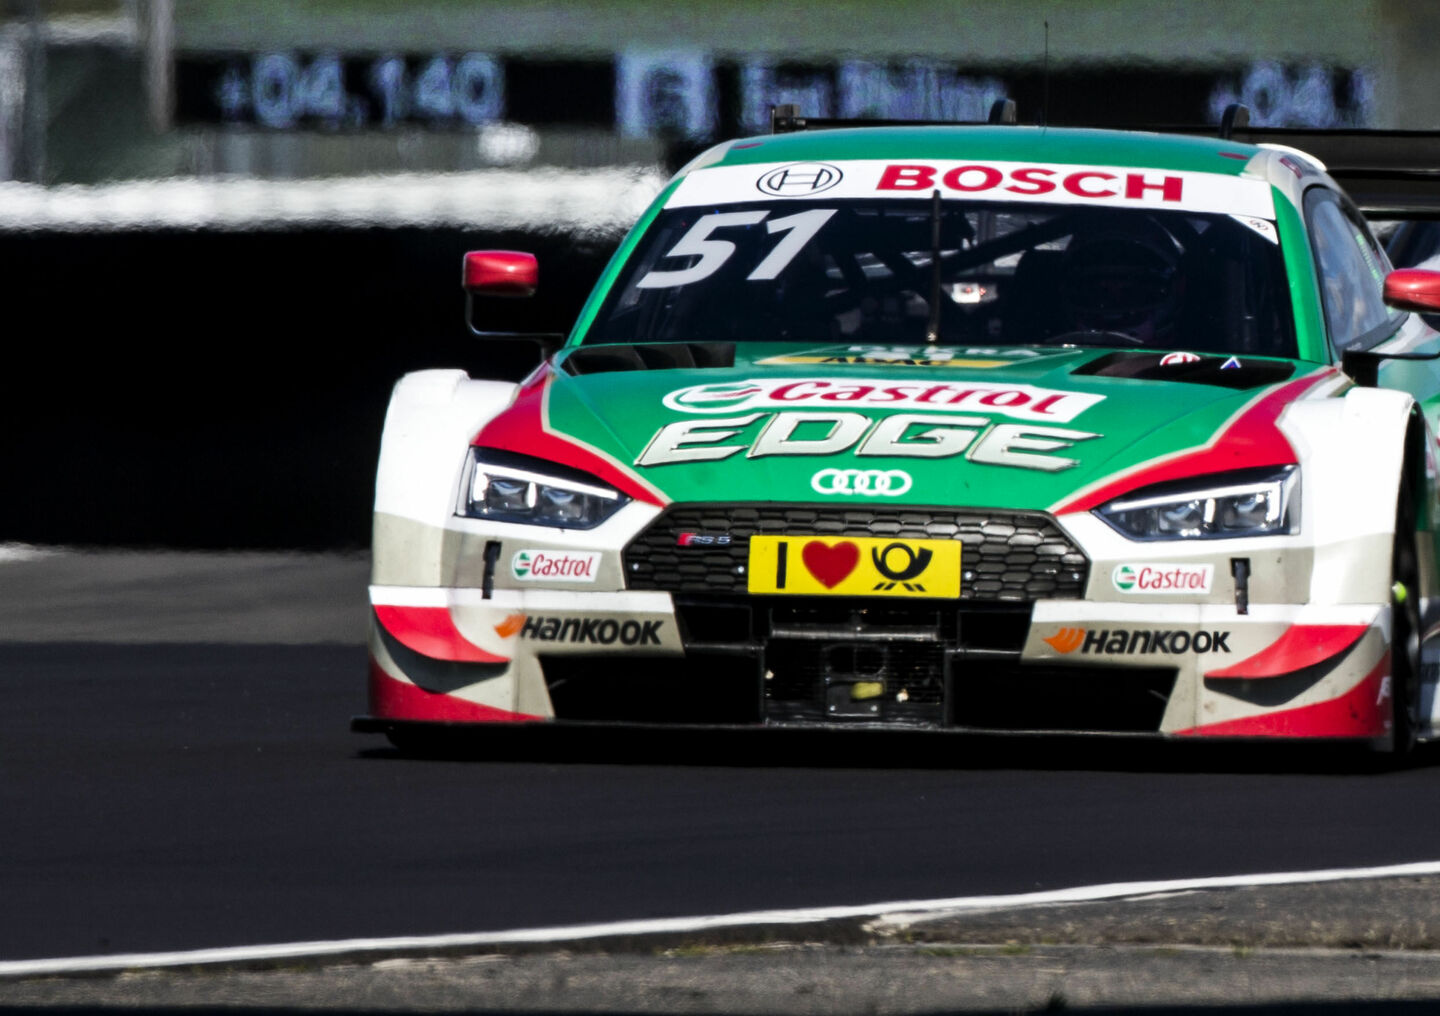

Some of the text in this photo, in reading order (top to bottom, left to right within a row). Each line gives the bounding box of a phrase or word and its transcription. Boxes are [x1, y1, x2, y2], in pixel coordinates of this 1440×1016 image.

[876, 164, 1184, 202] BOSCH
[636, 208, 839, 288] 51
[768, 381, 1069, 415] Castrol
[634, 411, 1105, 472] EDGE
[531, 553, 594, 577] Castrol
[776, 541, 788, 590] I
[1138, 567, 1207, 590] Castrol
